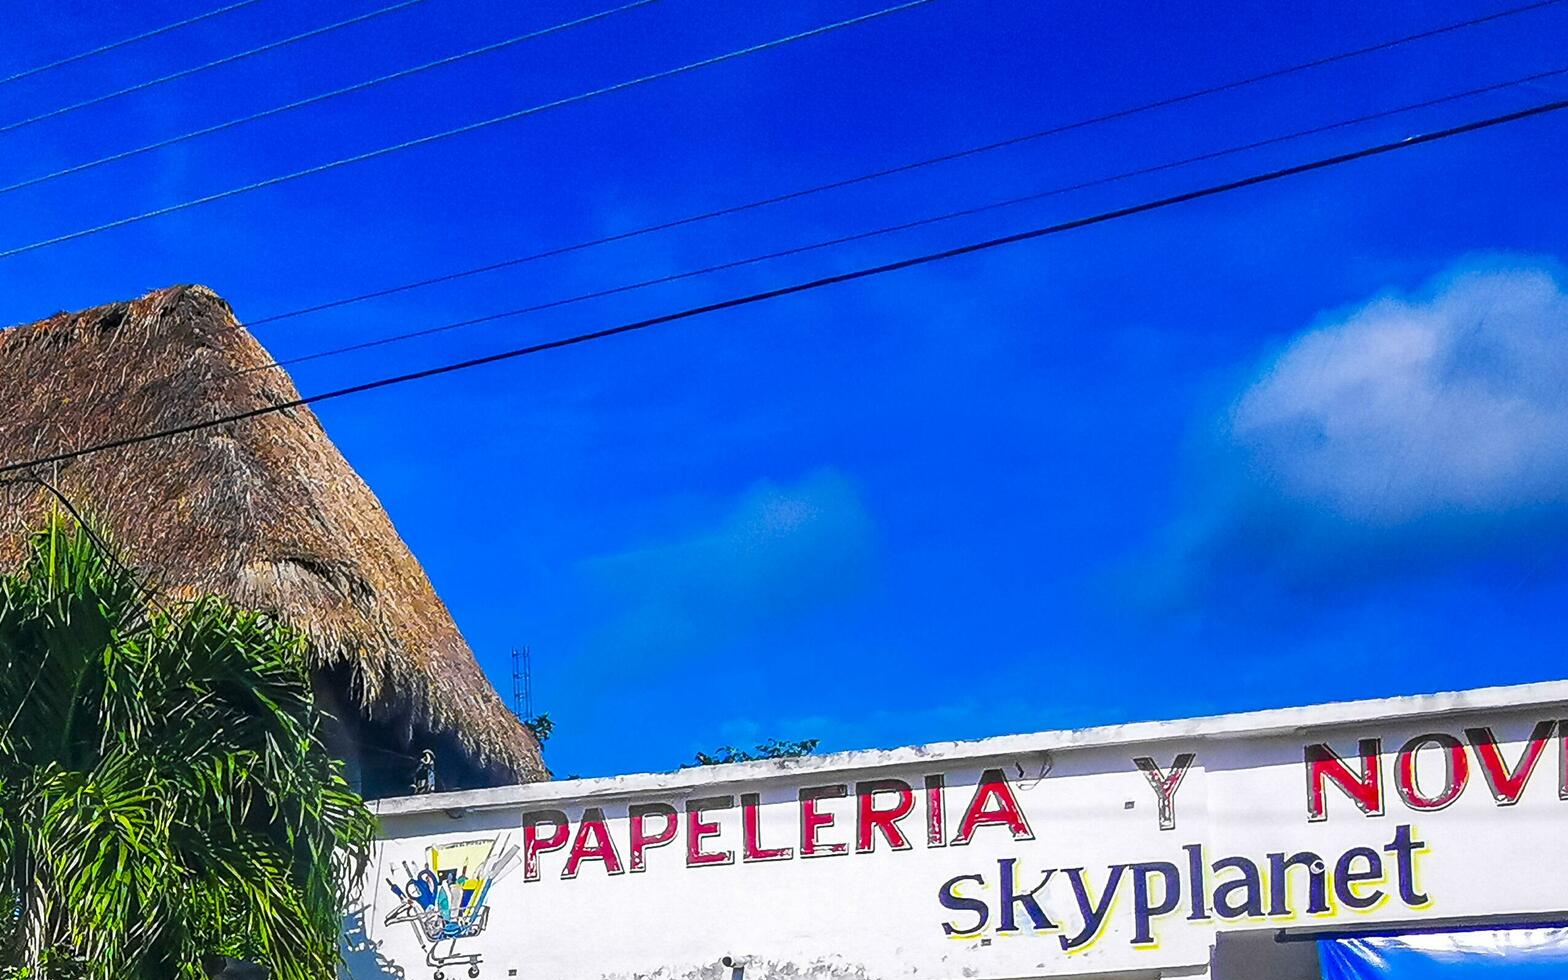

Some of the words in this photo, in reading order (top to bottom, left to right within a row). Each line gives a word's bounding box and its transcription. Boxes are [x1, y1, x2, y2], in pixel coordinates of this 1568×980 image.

[522, 767, 1034, 882] PAPELERIA
[1132, 753, 1196, 830] Y
[1304, 720, 1568, 823] NOV
[937, 825, 1432, 952] skyplanet
